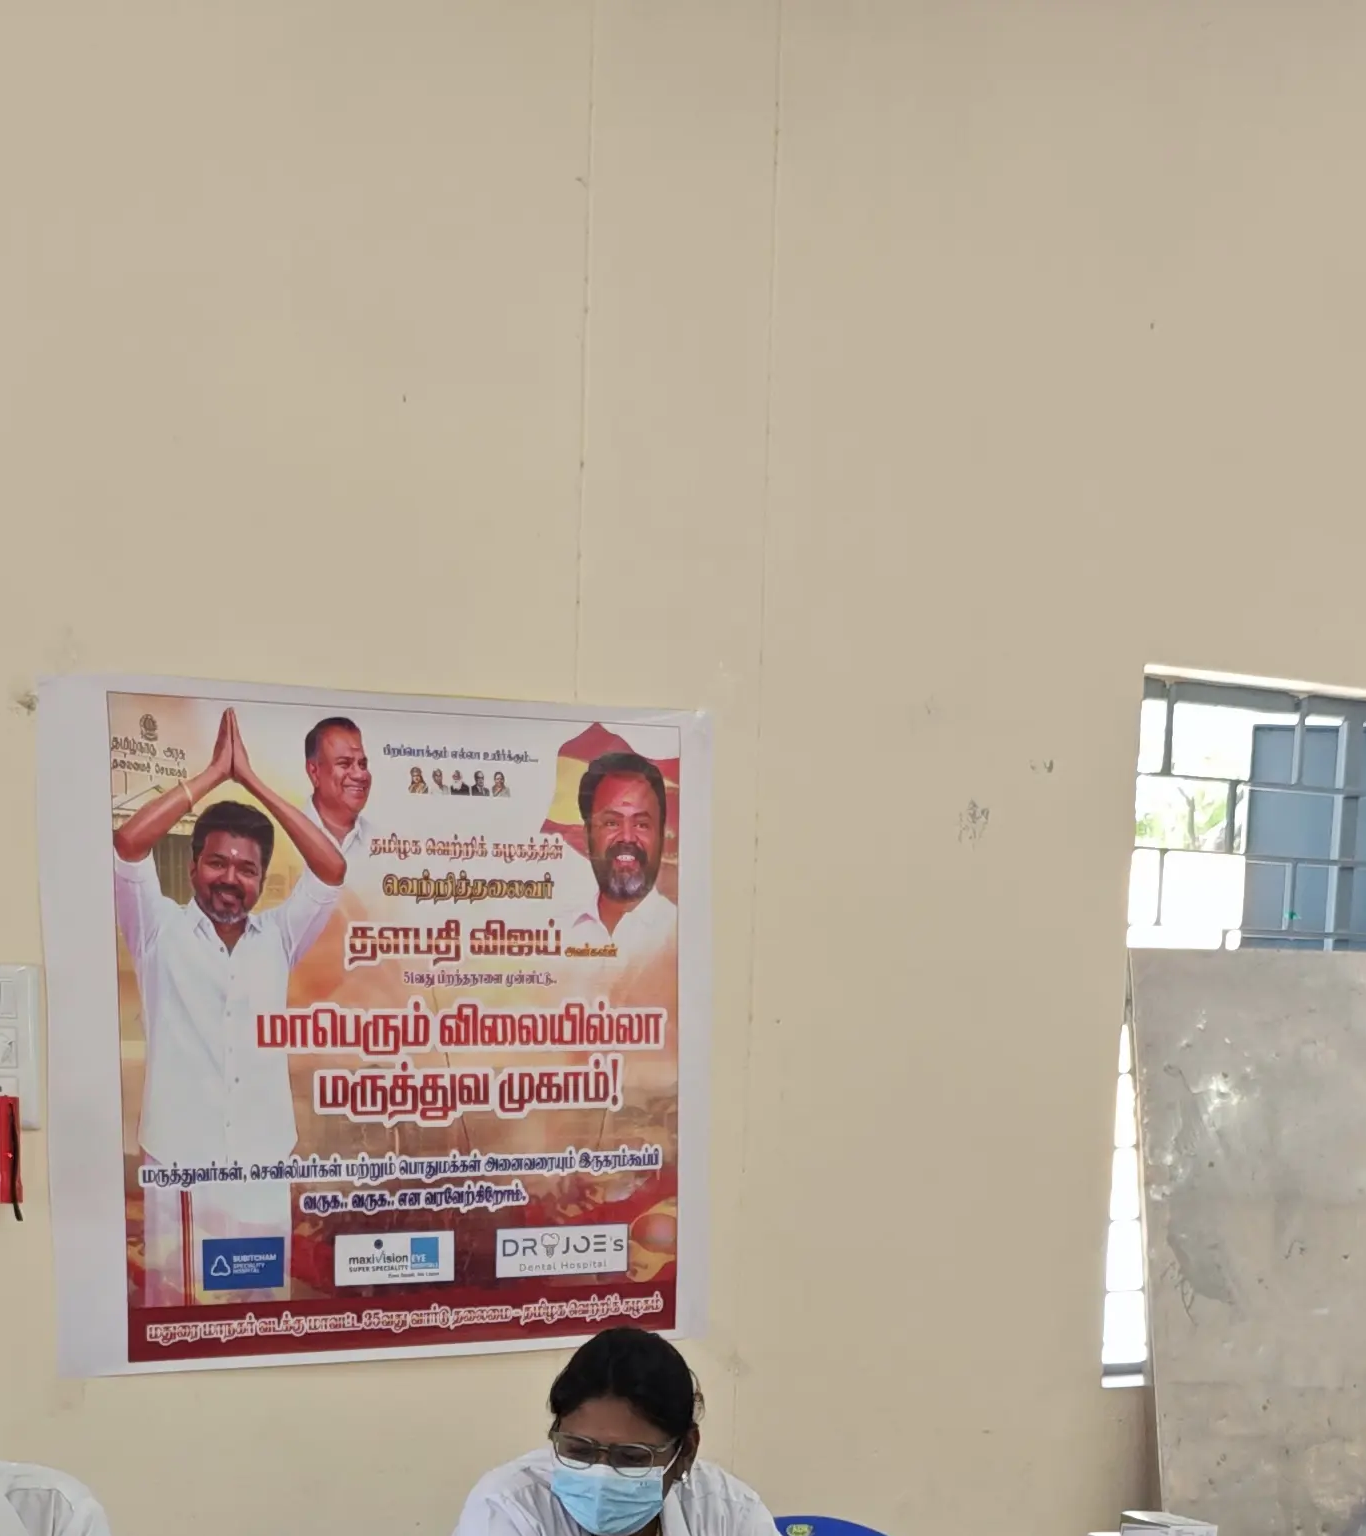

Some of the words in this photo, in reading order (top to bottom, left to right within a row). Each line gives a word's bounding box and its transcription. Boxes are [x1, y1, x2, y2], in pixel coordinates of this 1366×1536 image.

[450, 748, 480, 760] எல்லா
[369, 832, 421, 860] தமிழக
[425, 833, 488, 861] வெற்றிக்
[491, 837, 564, 863] கழகத்தின்
[383, 869, 554, 904] வெற்றித்தலைவர்
[348, 918, 461, 965] தளபதி
[469, 918, 562, 957] விஜய்
[256, 1001, 431, 1056] மாபெரும்
[439, 1000, 664, 1049] விலையில்லா
[319, 1061, 490, 1120] மருத்துவ
[499, 1058, 620, 1113] முகாம்!
[142, 1161, 247, 1187] மருத்துவர்கள்,
[250, 1157, 343, 1180] செவிலியர்கள்
[346, 1155, 396, 1182] மற்றும்
[399, 1152, 481, 1180] பொதுமக்கள்
[485, 1149, 576, 1173] அனைவரையும்
[398, 1190, 422, 1206] என
[502, 1238, 537, 1257] DR
[371, 1264, 409, 1272] SPECIALITY
[519, 1262, 557, 1272] Dental
[561, 1259, 607, 1270] Hospital
